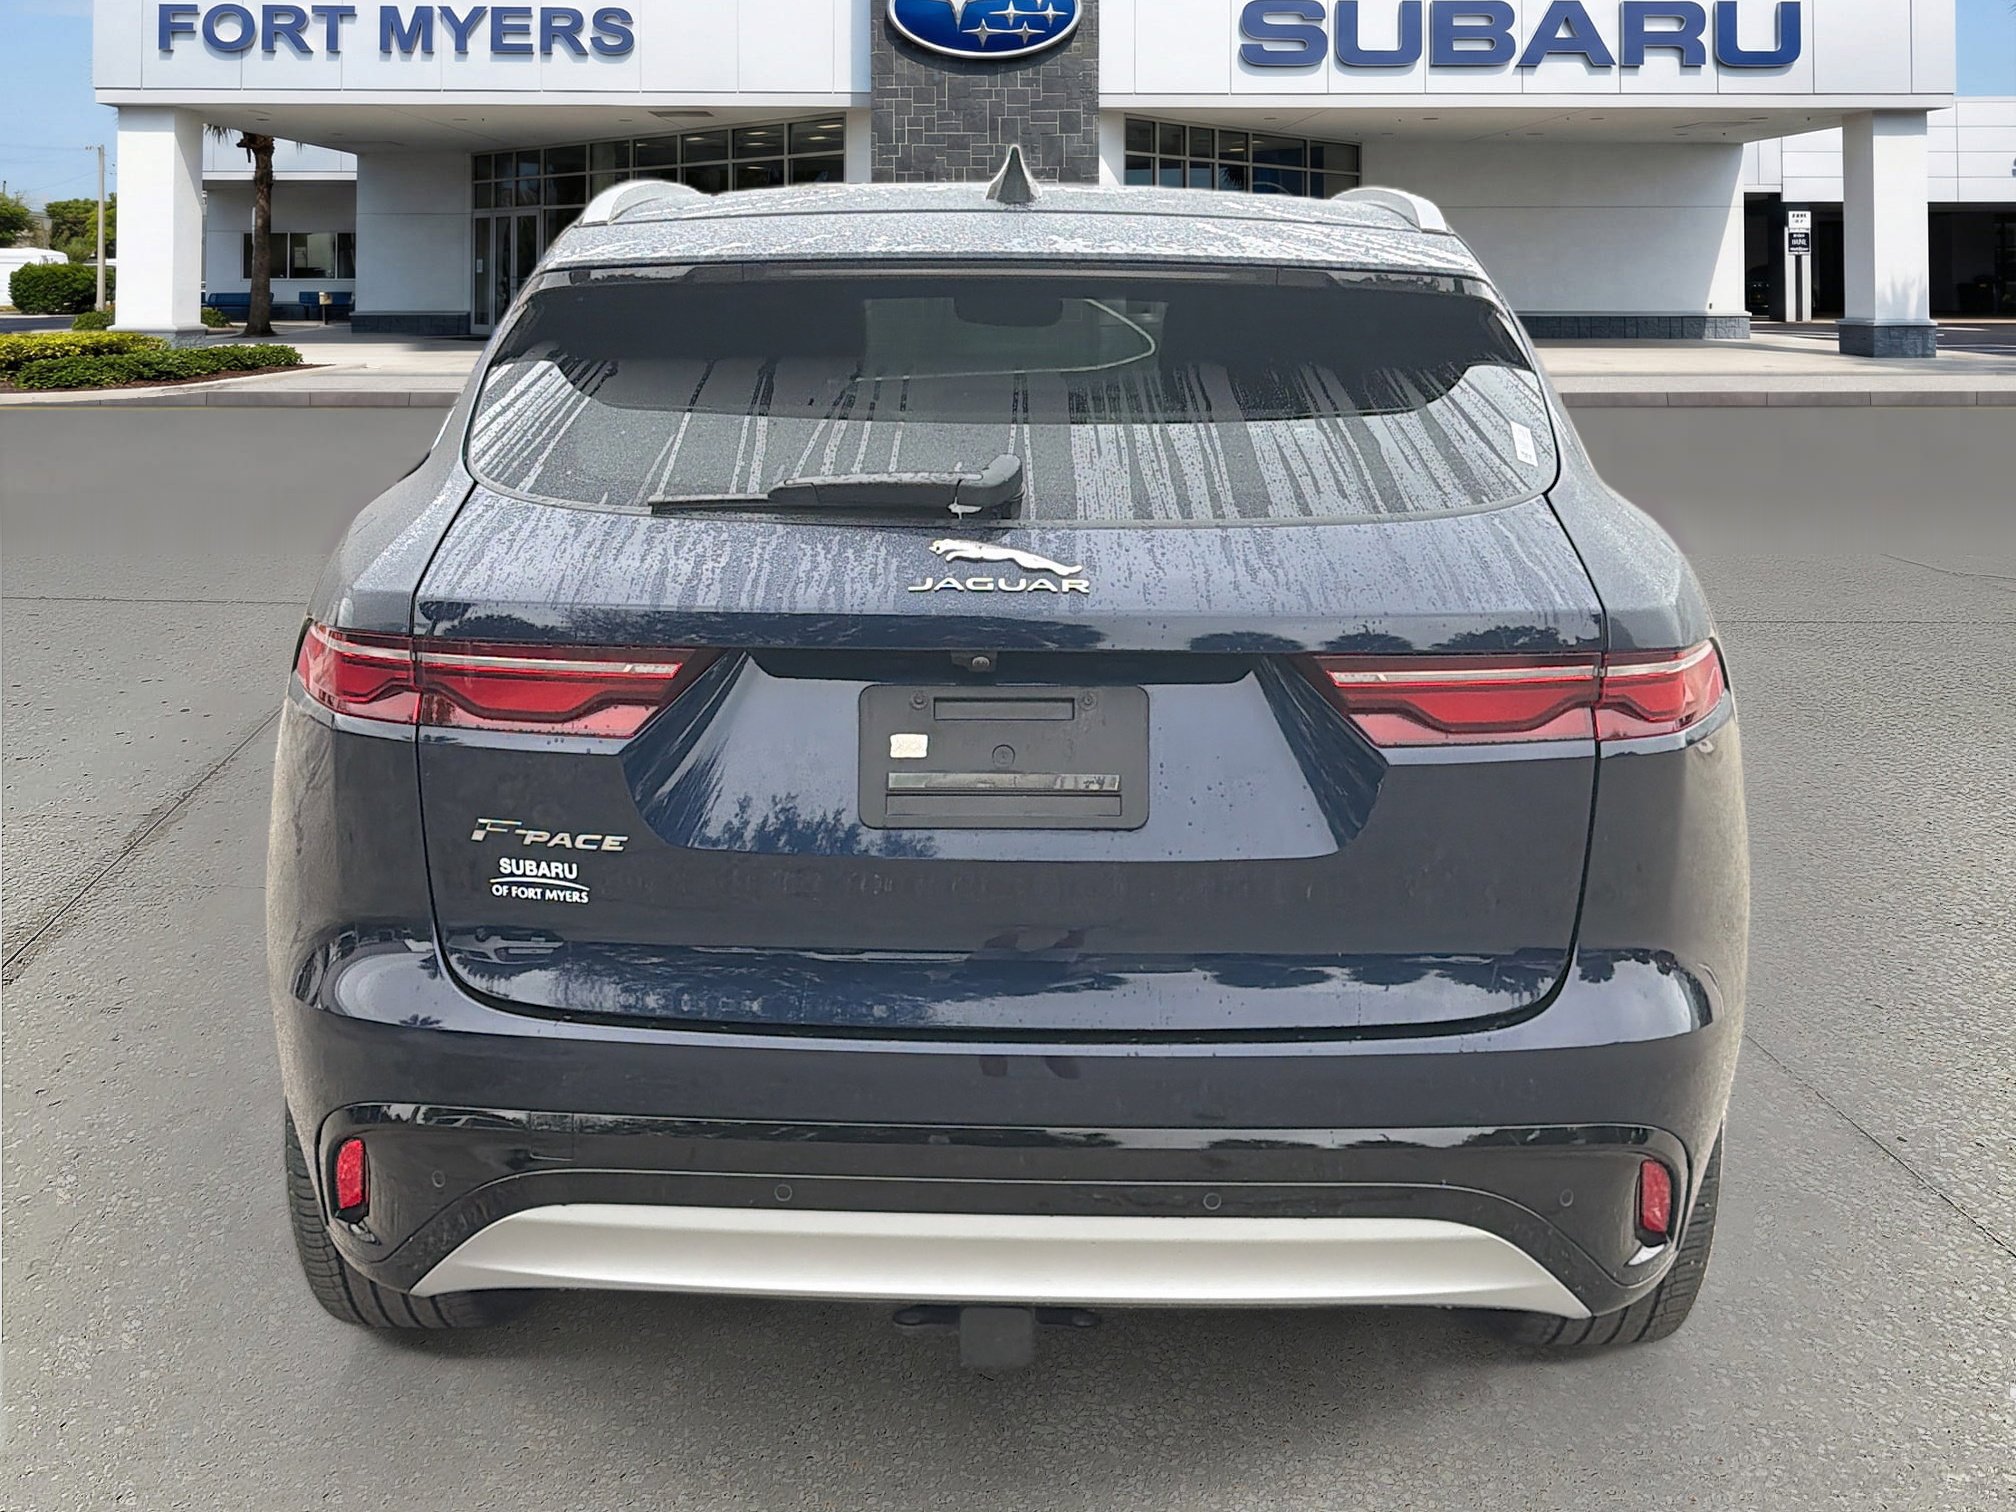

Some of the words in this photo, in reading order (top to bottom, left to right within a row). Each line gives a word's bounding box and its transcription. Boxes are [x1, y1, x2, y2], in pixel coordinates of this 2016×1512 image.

[158, 3, 357, 54] FORT
[379, 5, 637, 56] MYERS
[1239, 0, 1803, 69] SUBARU
[907, 576, 1091, 595] JAGUAR
[499, 857, 578, 880] SUBARU
[491, 884, 509, 897] OF
[511, 886, 543, 900] FORT
[545, 888, 589, 904] MYERS
